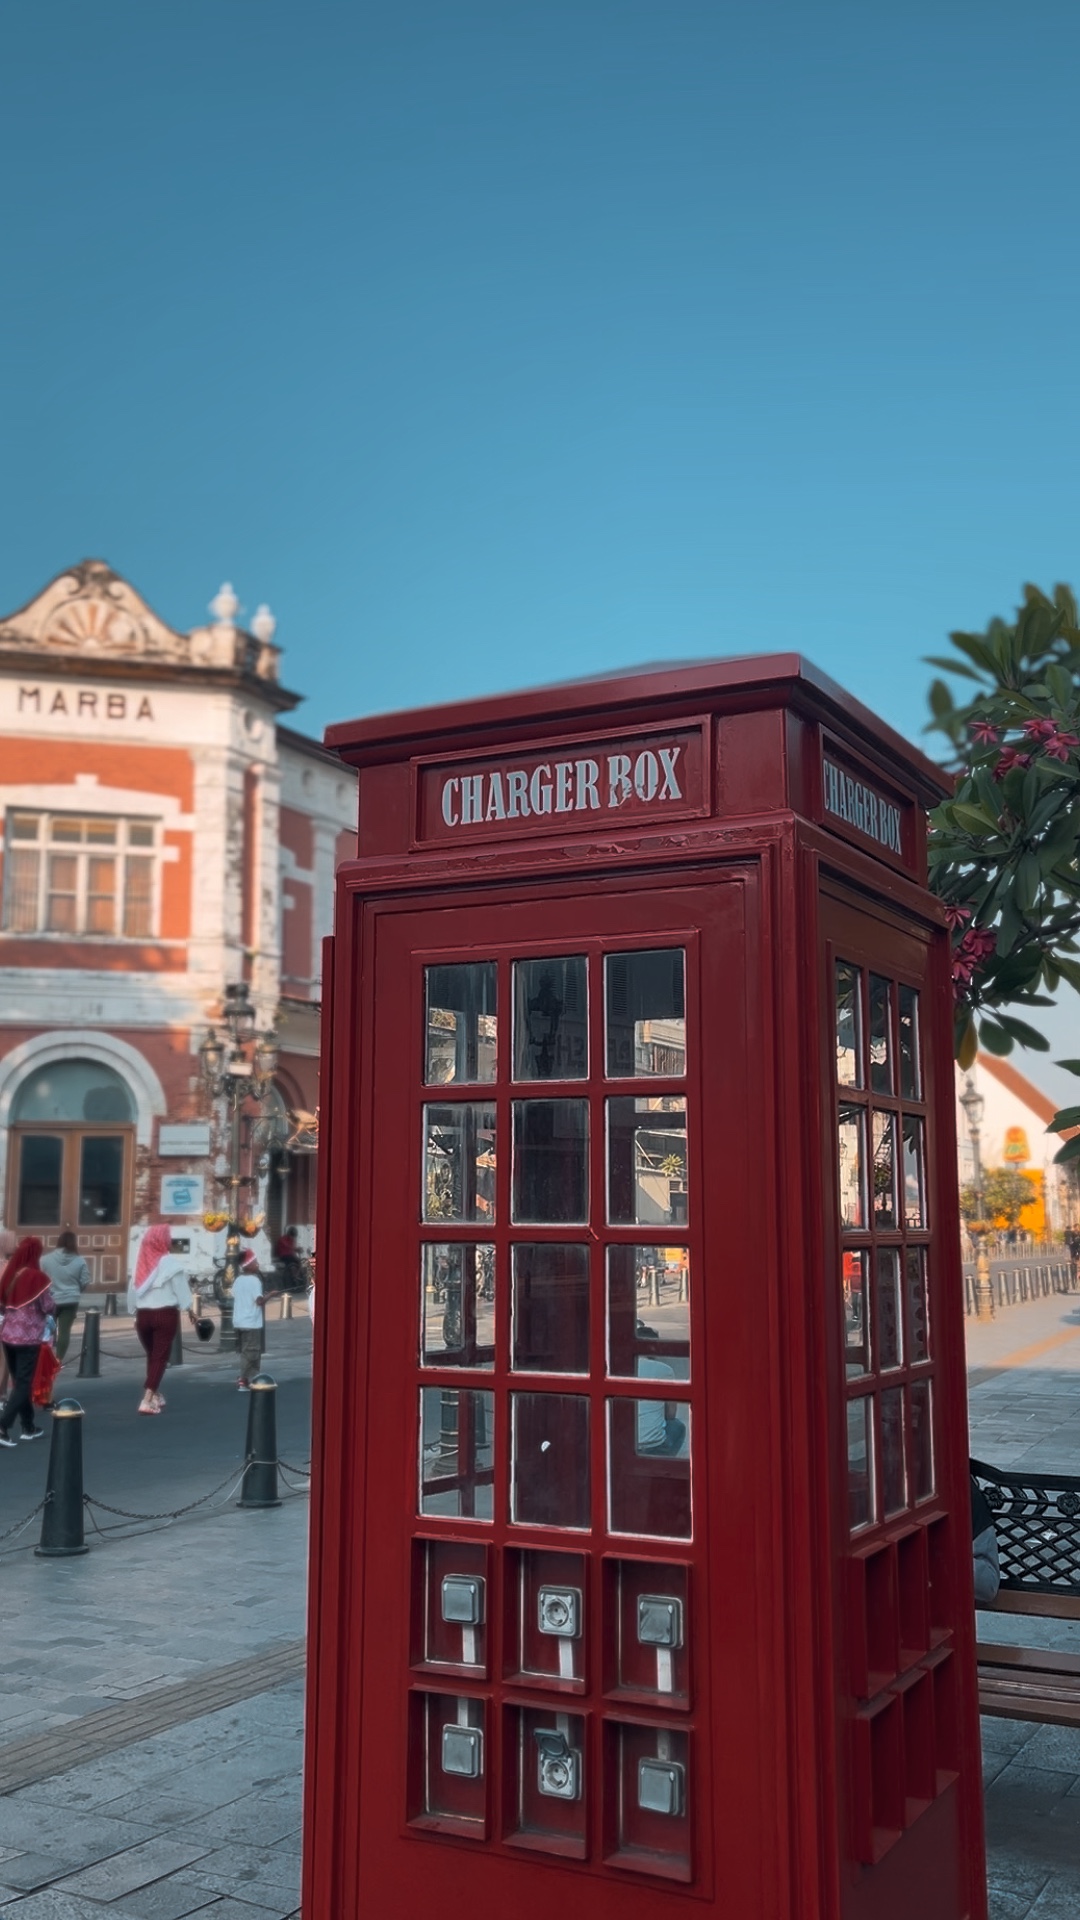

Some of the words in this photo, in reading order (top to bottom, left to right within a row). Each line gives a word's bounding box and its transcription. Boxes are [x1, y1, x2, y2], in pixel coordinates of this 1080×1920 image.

[18, 686, 154, 722] MARBA
[441, 759, 601, 827] CHARGER
[607, 747, 683, 808] BOX
[823, 759, 879, 840] CHARGER
[879, 798, 902, 856] BOX
